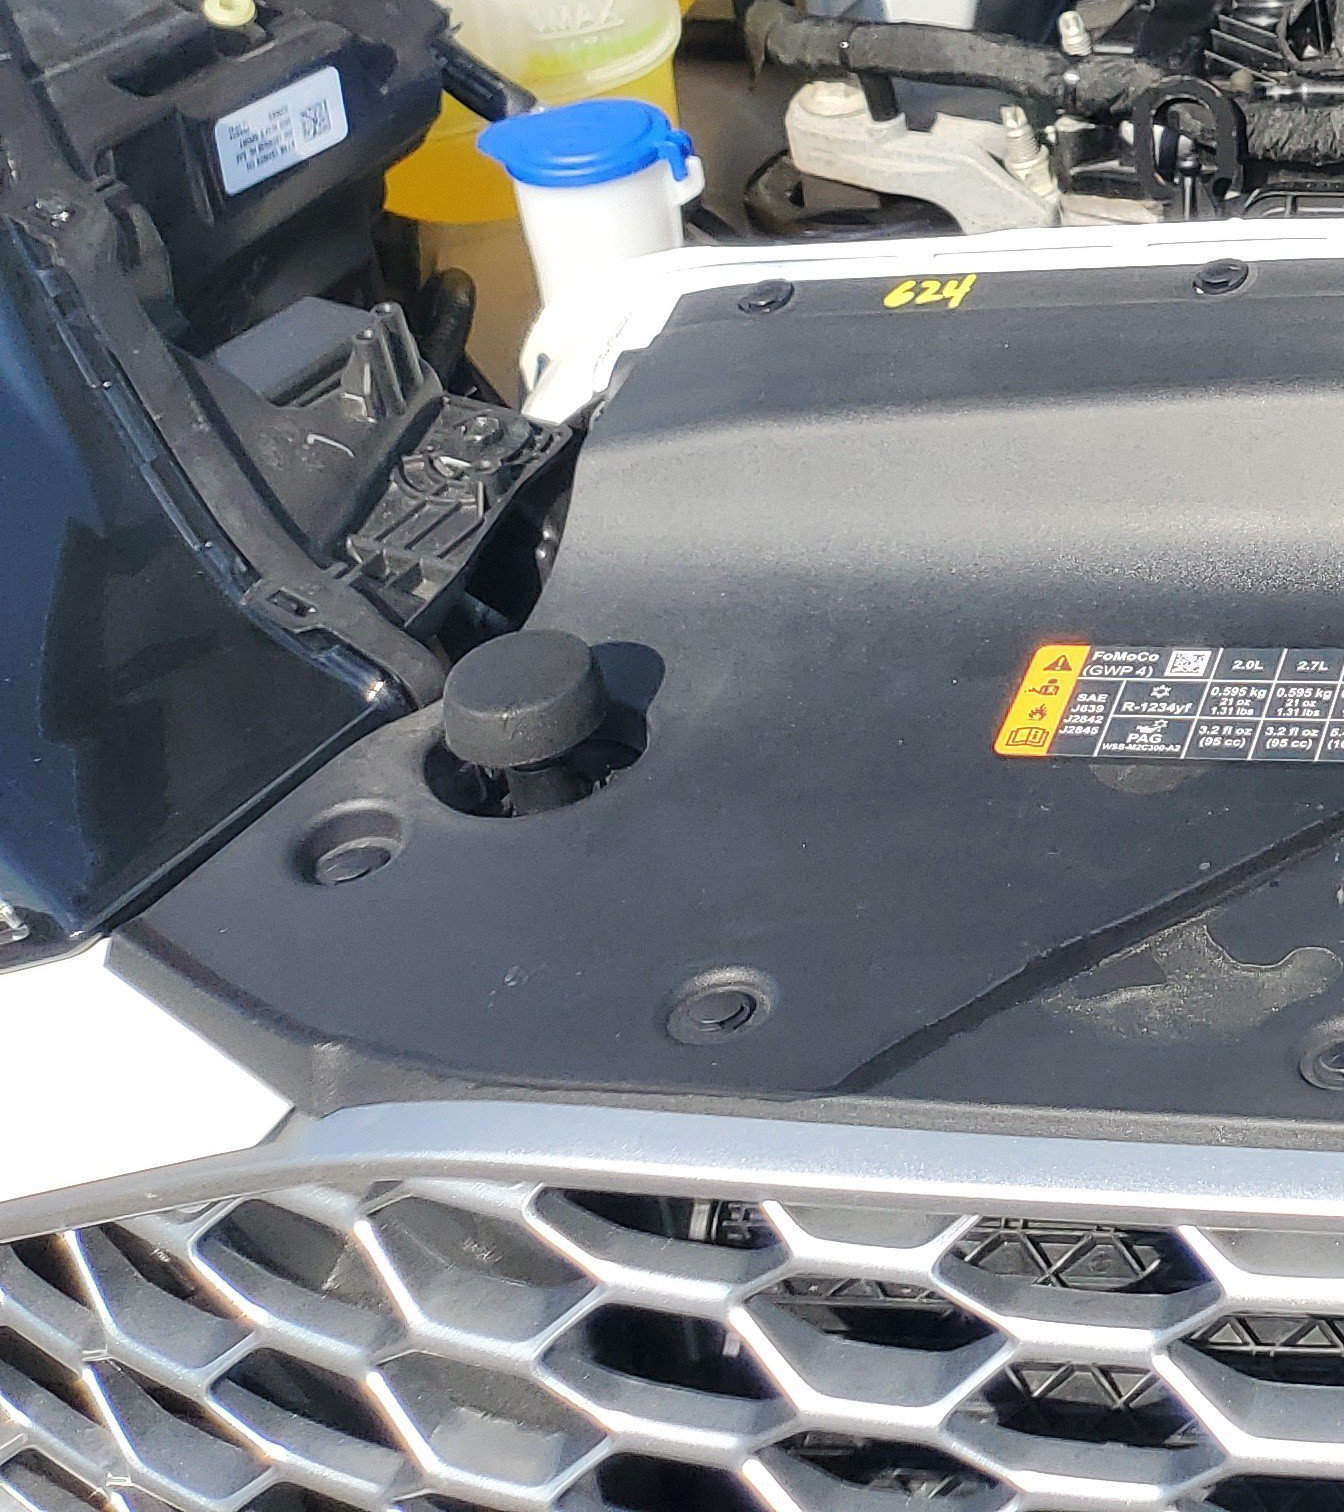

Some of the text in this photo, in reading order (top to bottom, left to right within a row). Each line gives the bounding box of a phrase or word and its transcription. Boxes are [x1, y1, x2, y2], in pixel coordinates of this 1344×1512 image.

[882, 273, 978, 309] 624
[1091, 651, 1160, 663] FoMoCo
[1231, 659, 1265, 671] 2.0L
[1296, 660, 1329, 672] 2.7L
[1082, 665, 1154, 678] (GWP 4)
[1210, 686, 1268, 699] 0.595 kg
[1276, 688, 1333, 700] 0.595 kg
[1076, 694, 1109, 703] SAE
[1219, 698, 1233, 706] 21
[1285, 698, 1317, 708] 21 oz
[1121, 702, 1193, 715] R-1234yf
[1210, 707, 1255, 716] 1.31 lbs
[1276, 708, 1321, 717] 1.31 lbs
[1198, 725, 1253, 736] 3.2 fl oz
[1265, 726, 1320, 737] 3.2 fl oz
[1126, 733, 1163, 744] PAG
[1198, 737, 1246, 748] (95 cc)
[1265, 738, 1313, 750] (95 cc)
